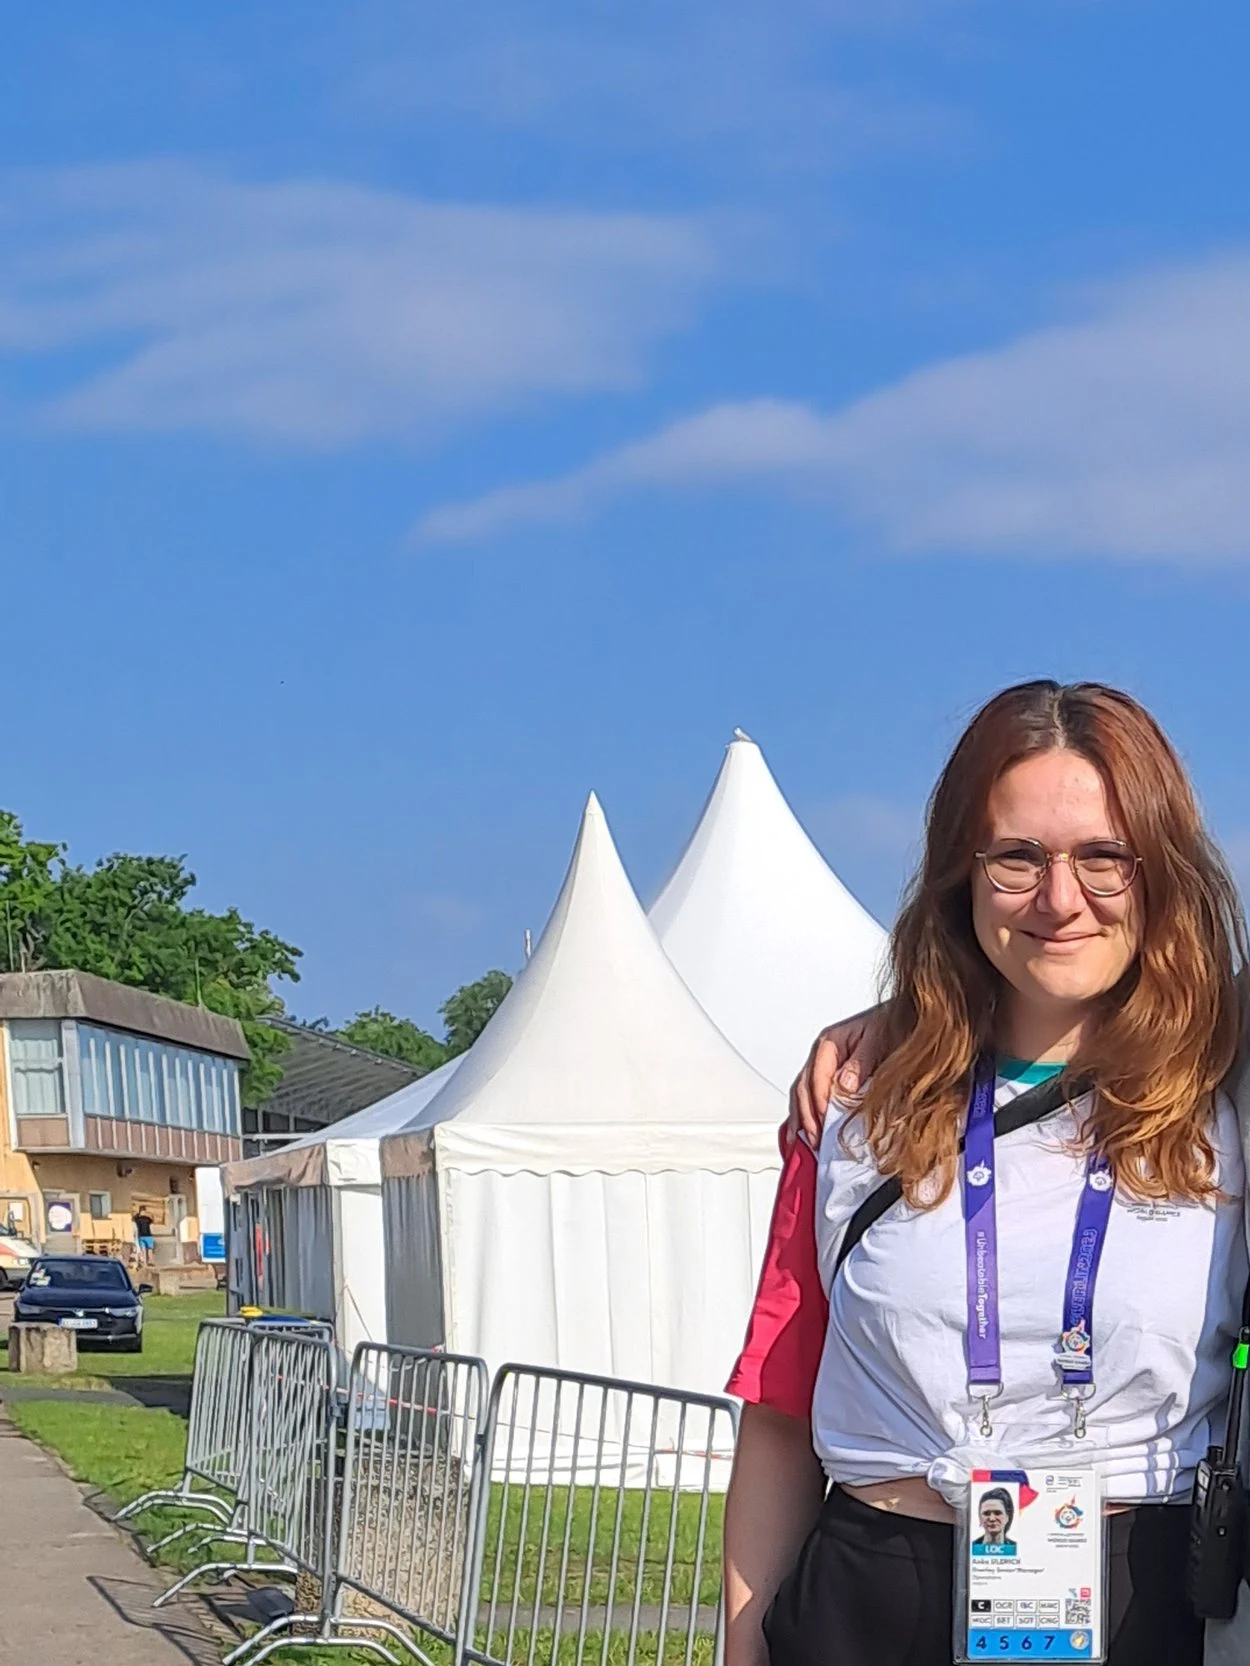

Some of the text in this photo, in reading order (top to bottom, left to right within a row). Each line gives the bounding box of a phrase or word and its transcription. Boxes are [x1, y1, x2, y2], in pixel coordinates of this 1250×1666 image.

[975, 1635, 1055, 1650] 4 5 6 7
